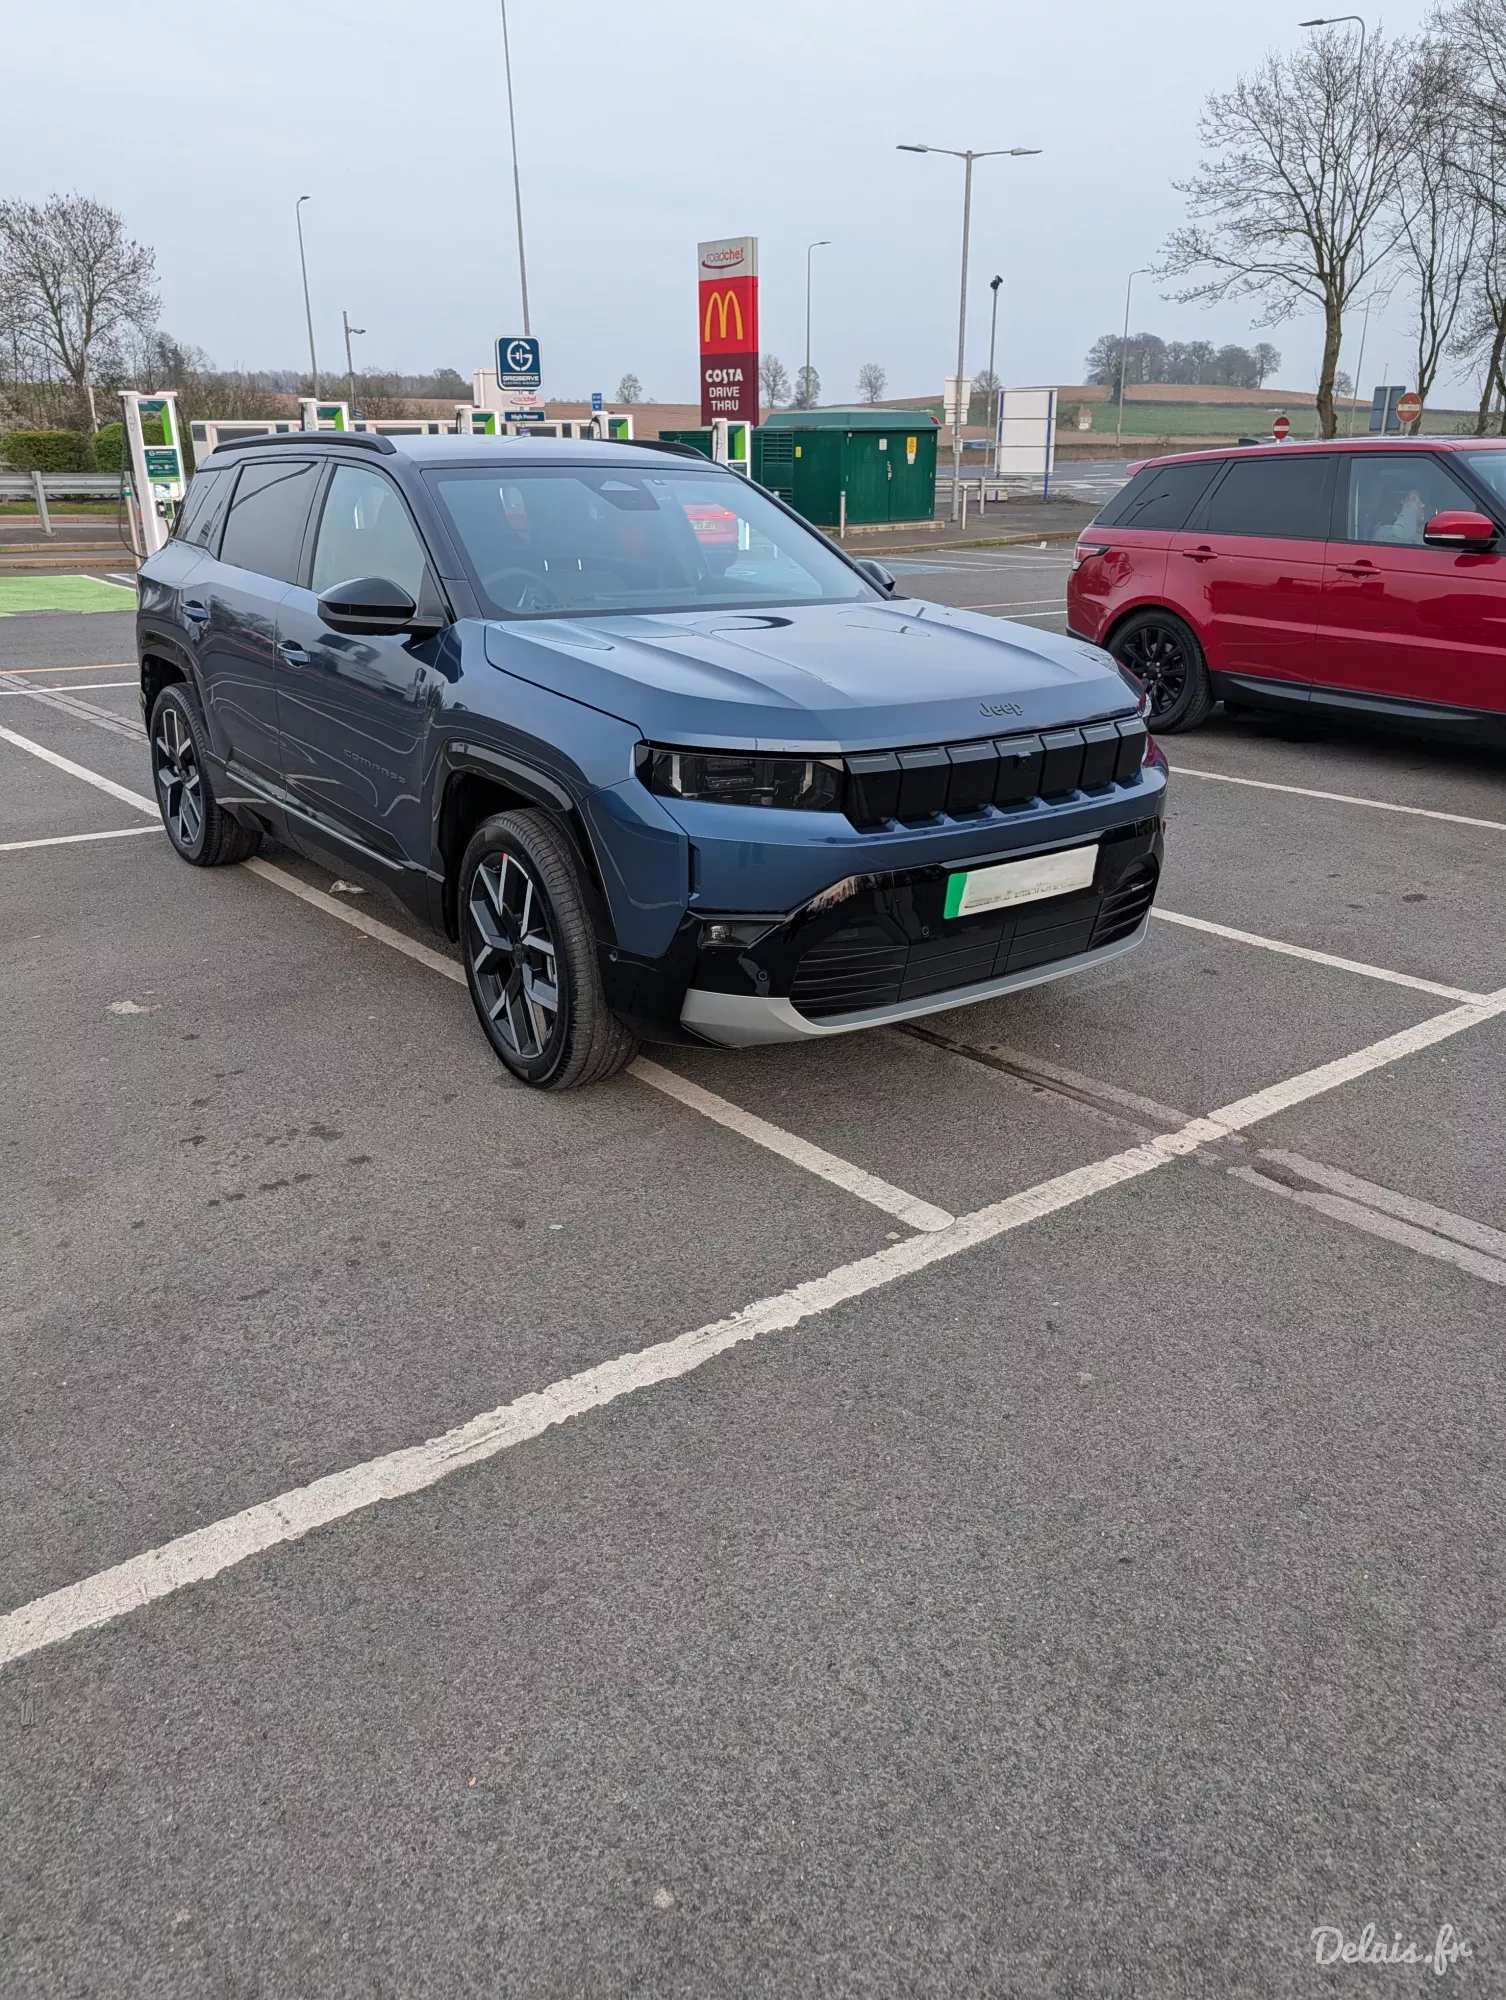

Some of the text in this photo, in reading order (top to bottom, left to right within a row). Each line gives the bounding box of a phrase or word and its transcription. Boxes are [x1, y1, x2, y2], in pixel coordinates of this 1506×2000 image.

[706, 247, 744, 263] roadchef
[705, 368, 744, 384] COSTA
[709, 386, 740, 398] DRIVE
[711, 400, 739, 411] THRU
[510, 413, 523, 421] High
[979, 702, 1024, 717] Jeep
[343, 749, 407, 784] COMPASS
